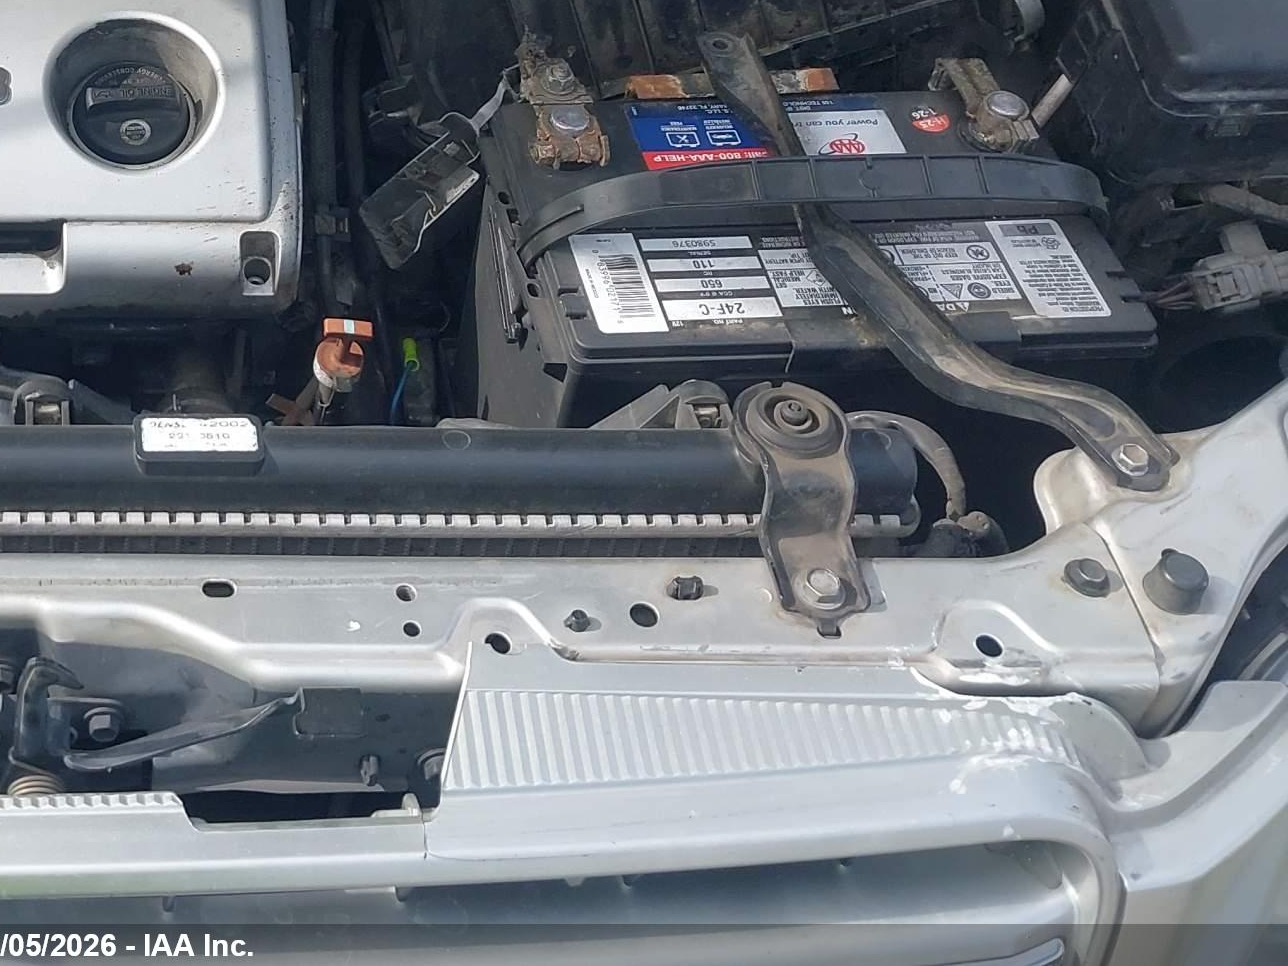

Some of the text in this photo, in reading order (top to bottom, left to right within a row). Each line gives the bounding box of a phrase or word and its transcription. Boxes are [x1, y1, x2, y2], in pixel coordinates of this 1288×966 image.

[653, 153, 742, 162] 800-AAA-HELP
[1016, 225, 1039, 234] Pb
[672, 239, 716, 248] 5980376
[693, 259, 714, 269] 110
[700, 279, 723, 289] 650
[698, 302, 745, 316] 24F-C
